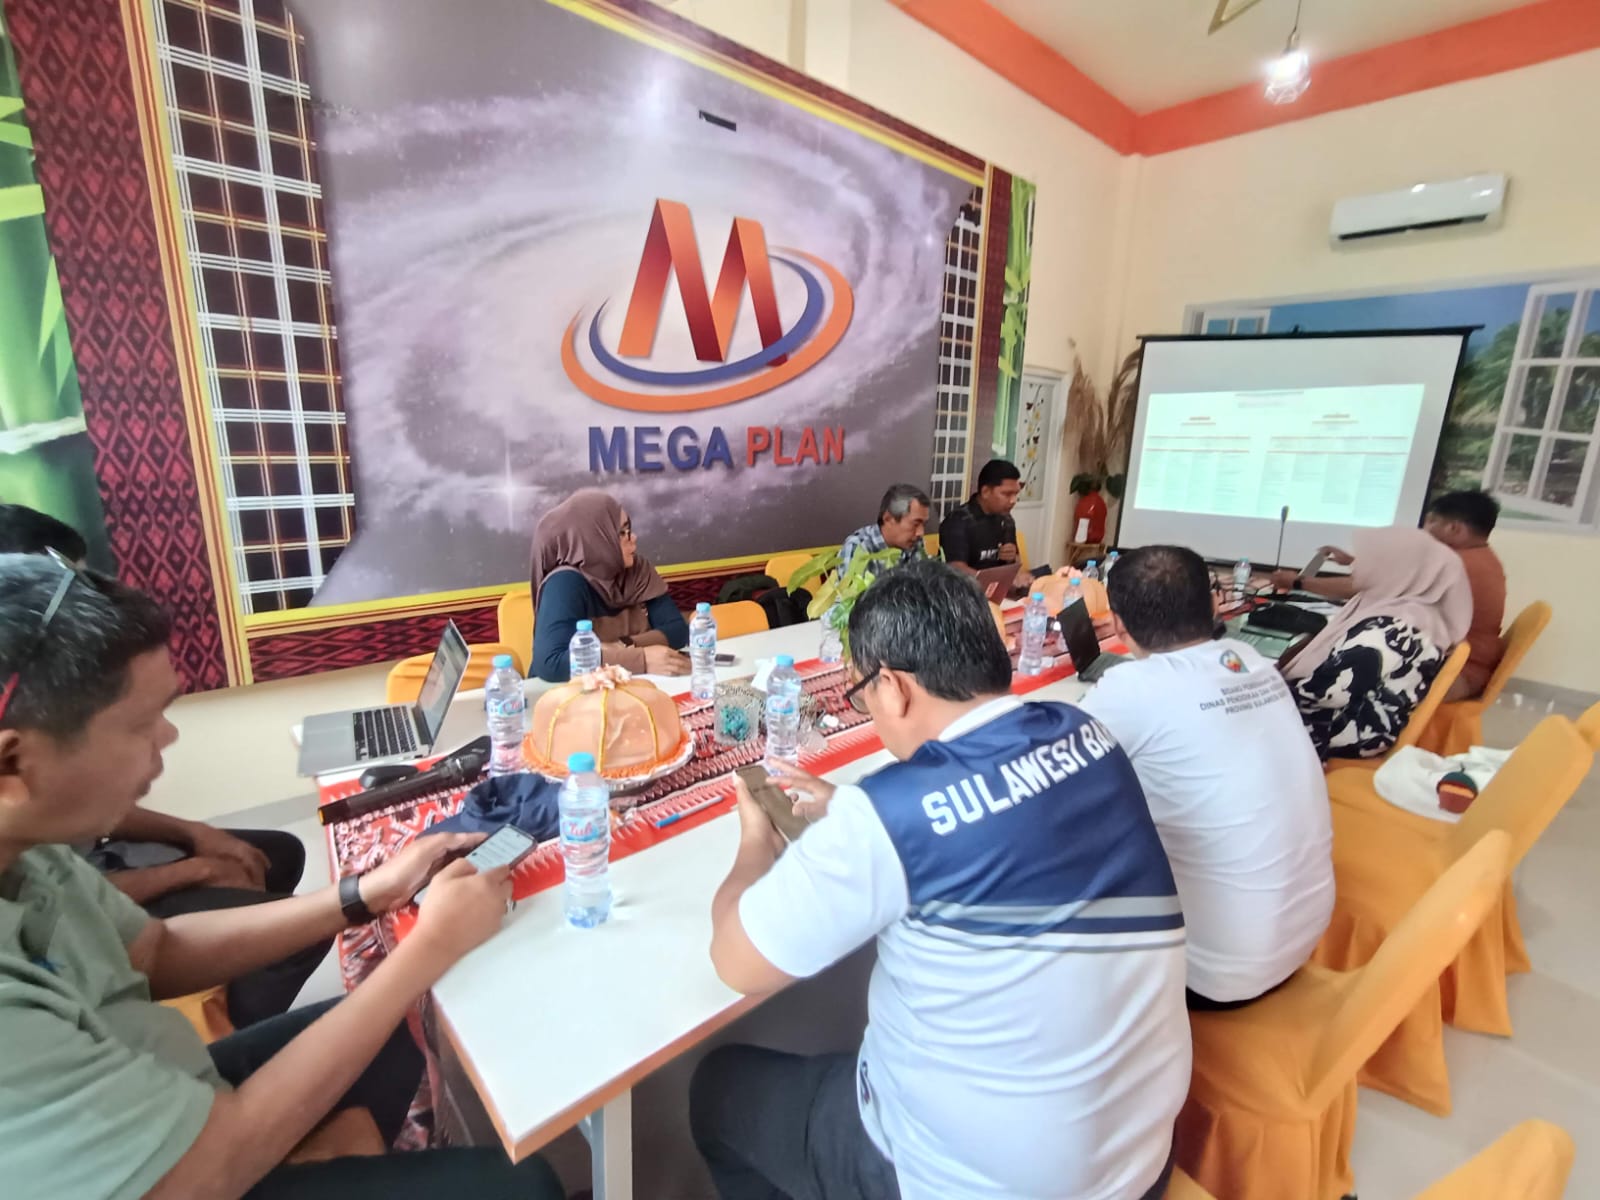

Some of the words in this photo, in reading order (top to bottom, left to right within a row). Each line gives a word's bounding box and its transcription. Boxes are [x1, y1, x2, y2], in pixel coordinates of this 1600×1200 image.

[588, 426, 734, 472] MEGA
[746, 426, 845, 467] PLAN
[1199, 697, 1226, 711] DINAS
[921, 732, 1088, 836] SULAWESI
